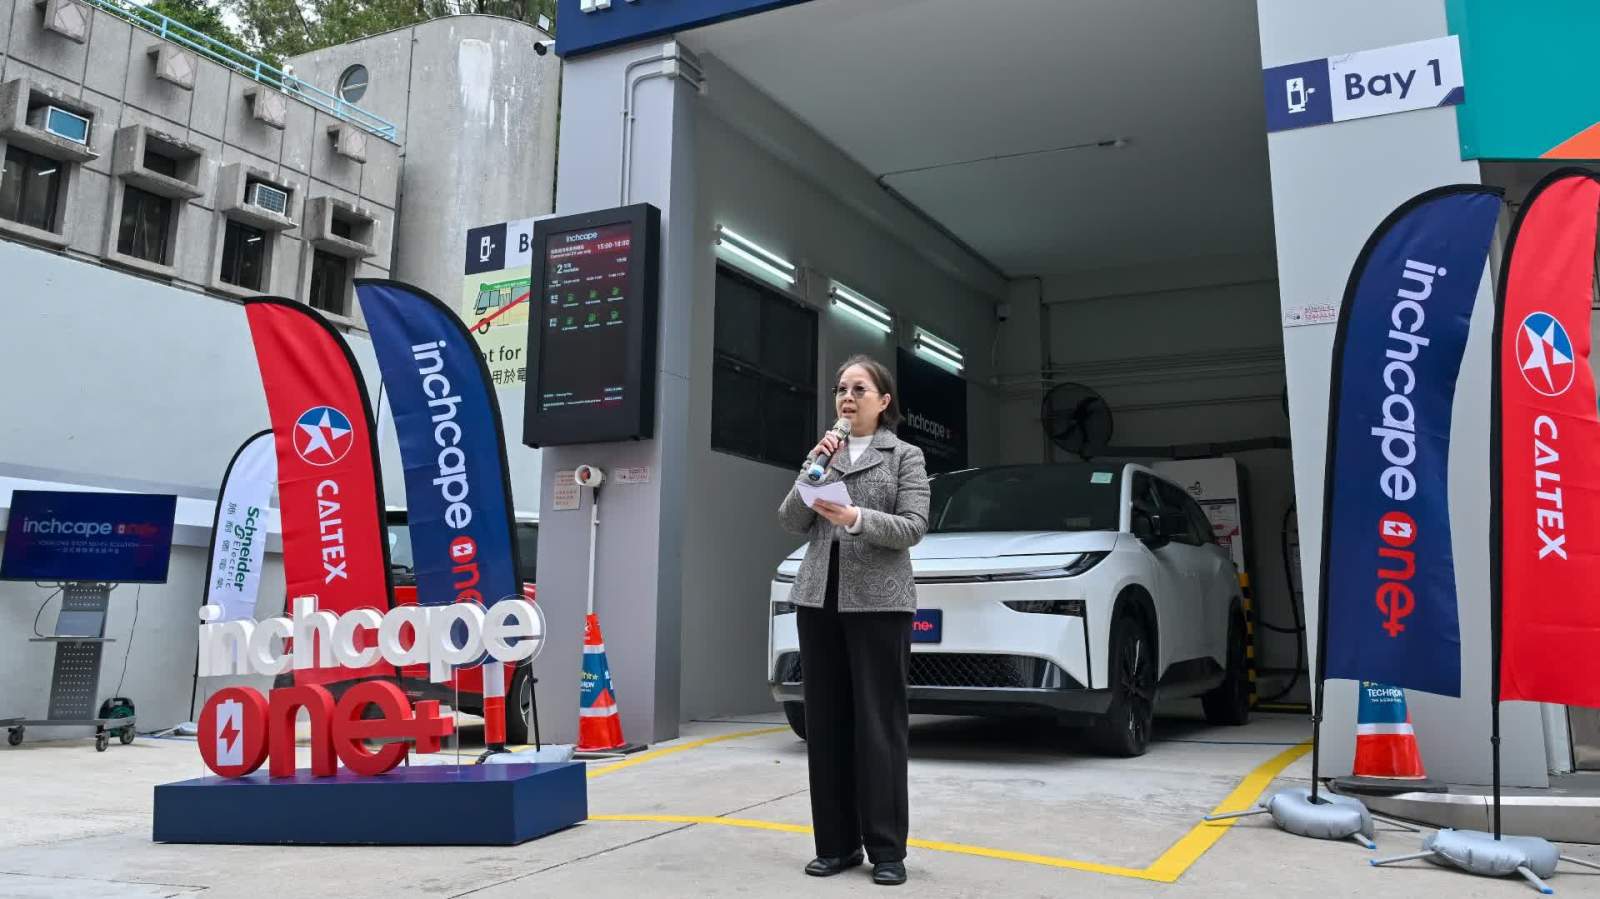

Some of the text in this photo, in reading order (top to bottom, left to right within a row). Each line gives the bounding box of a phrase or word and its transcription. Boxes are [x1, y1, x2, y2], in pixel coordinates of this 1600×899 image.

[1344, 58, 1442, 101] Bay 1
[566, 231, 598, 243] inchcape
[499, 345, 522, 362] for
[1371, 259, 1447, 501] inchcape
[411, 340, 473, 529] inchcape
[907, 408, 945, 440] inchcape
[1534, 415, 1567, 561] CALTEX
[22, 517, 112, 538] inchcape
[234, 506, 259, 592] Schneider
[316, 479, 348, 585] CALTEX
[198, 597, 543, 684] inchcape
[1367, 688, 1403, 698] TECHRON
